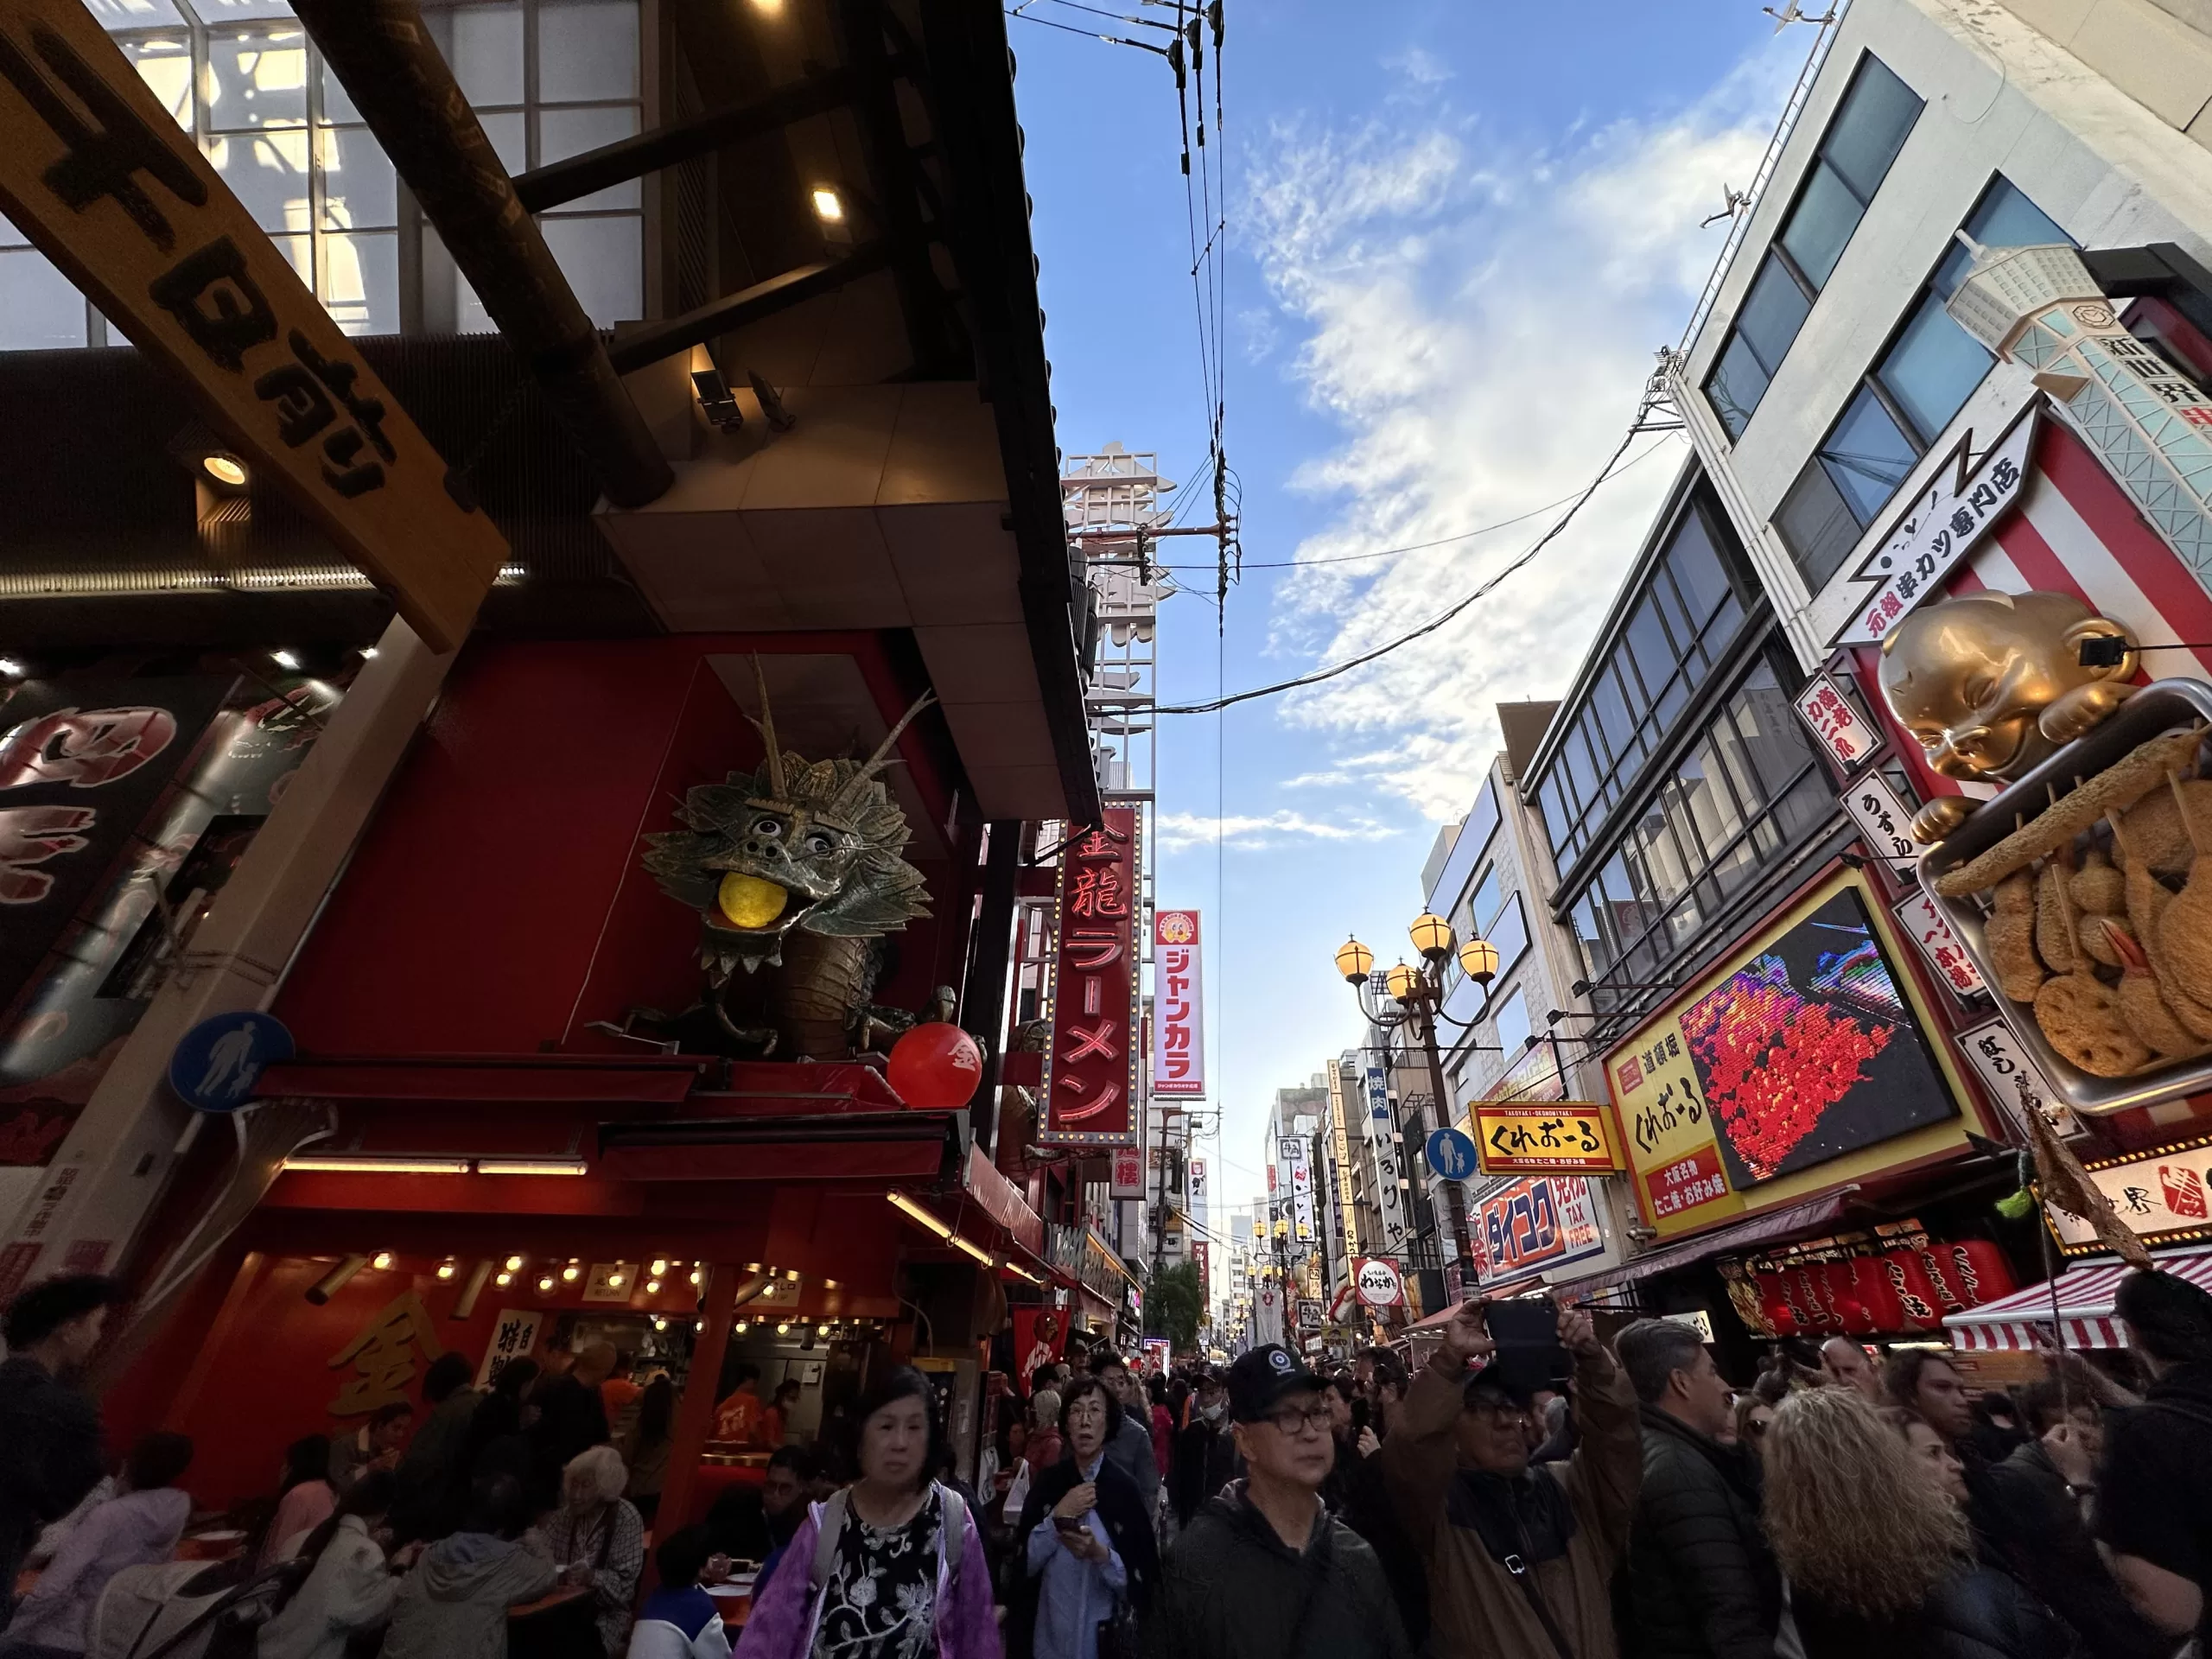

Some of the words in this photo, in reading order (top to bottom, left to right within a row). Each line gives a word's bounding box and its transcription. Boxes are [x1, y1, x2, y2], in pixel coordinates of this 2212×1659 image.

[1865, 456, 2021, 638] 元祖串カツ専門店
[1057, 823, 1129, 1123] 金龍ラーメン
[1164, 949, 1191, 1080] ジャンカラ
[1641, 1032, 1681, 1076] 道頓堀
[1368, 1075, 1388, 1112] 焼肉
[1635, 1077, 1702, 1154] くれおーる
[1490, 1118, 1600, 1156] くれおーる
[1375, 1132, 1404, 1245] いろりや
[1663, 1159, 1698, 1187] 大阪名物
[1489, 1179, 1557, 1267] ダイコク
[1566, 1202, 1585, 1225] TAX
[1568, 1224, 1593, 1249] FREE
[1360, 1273, 1395, 1290] わなか
